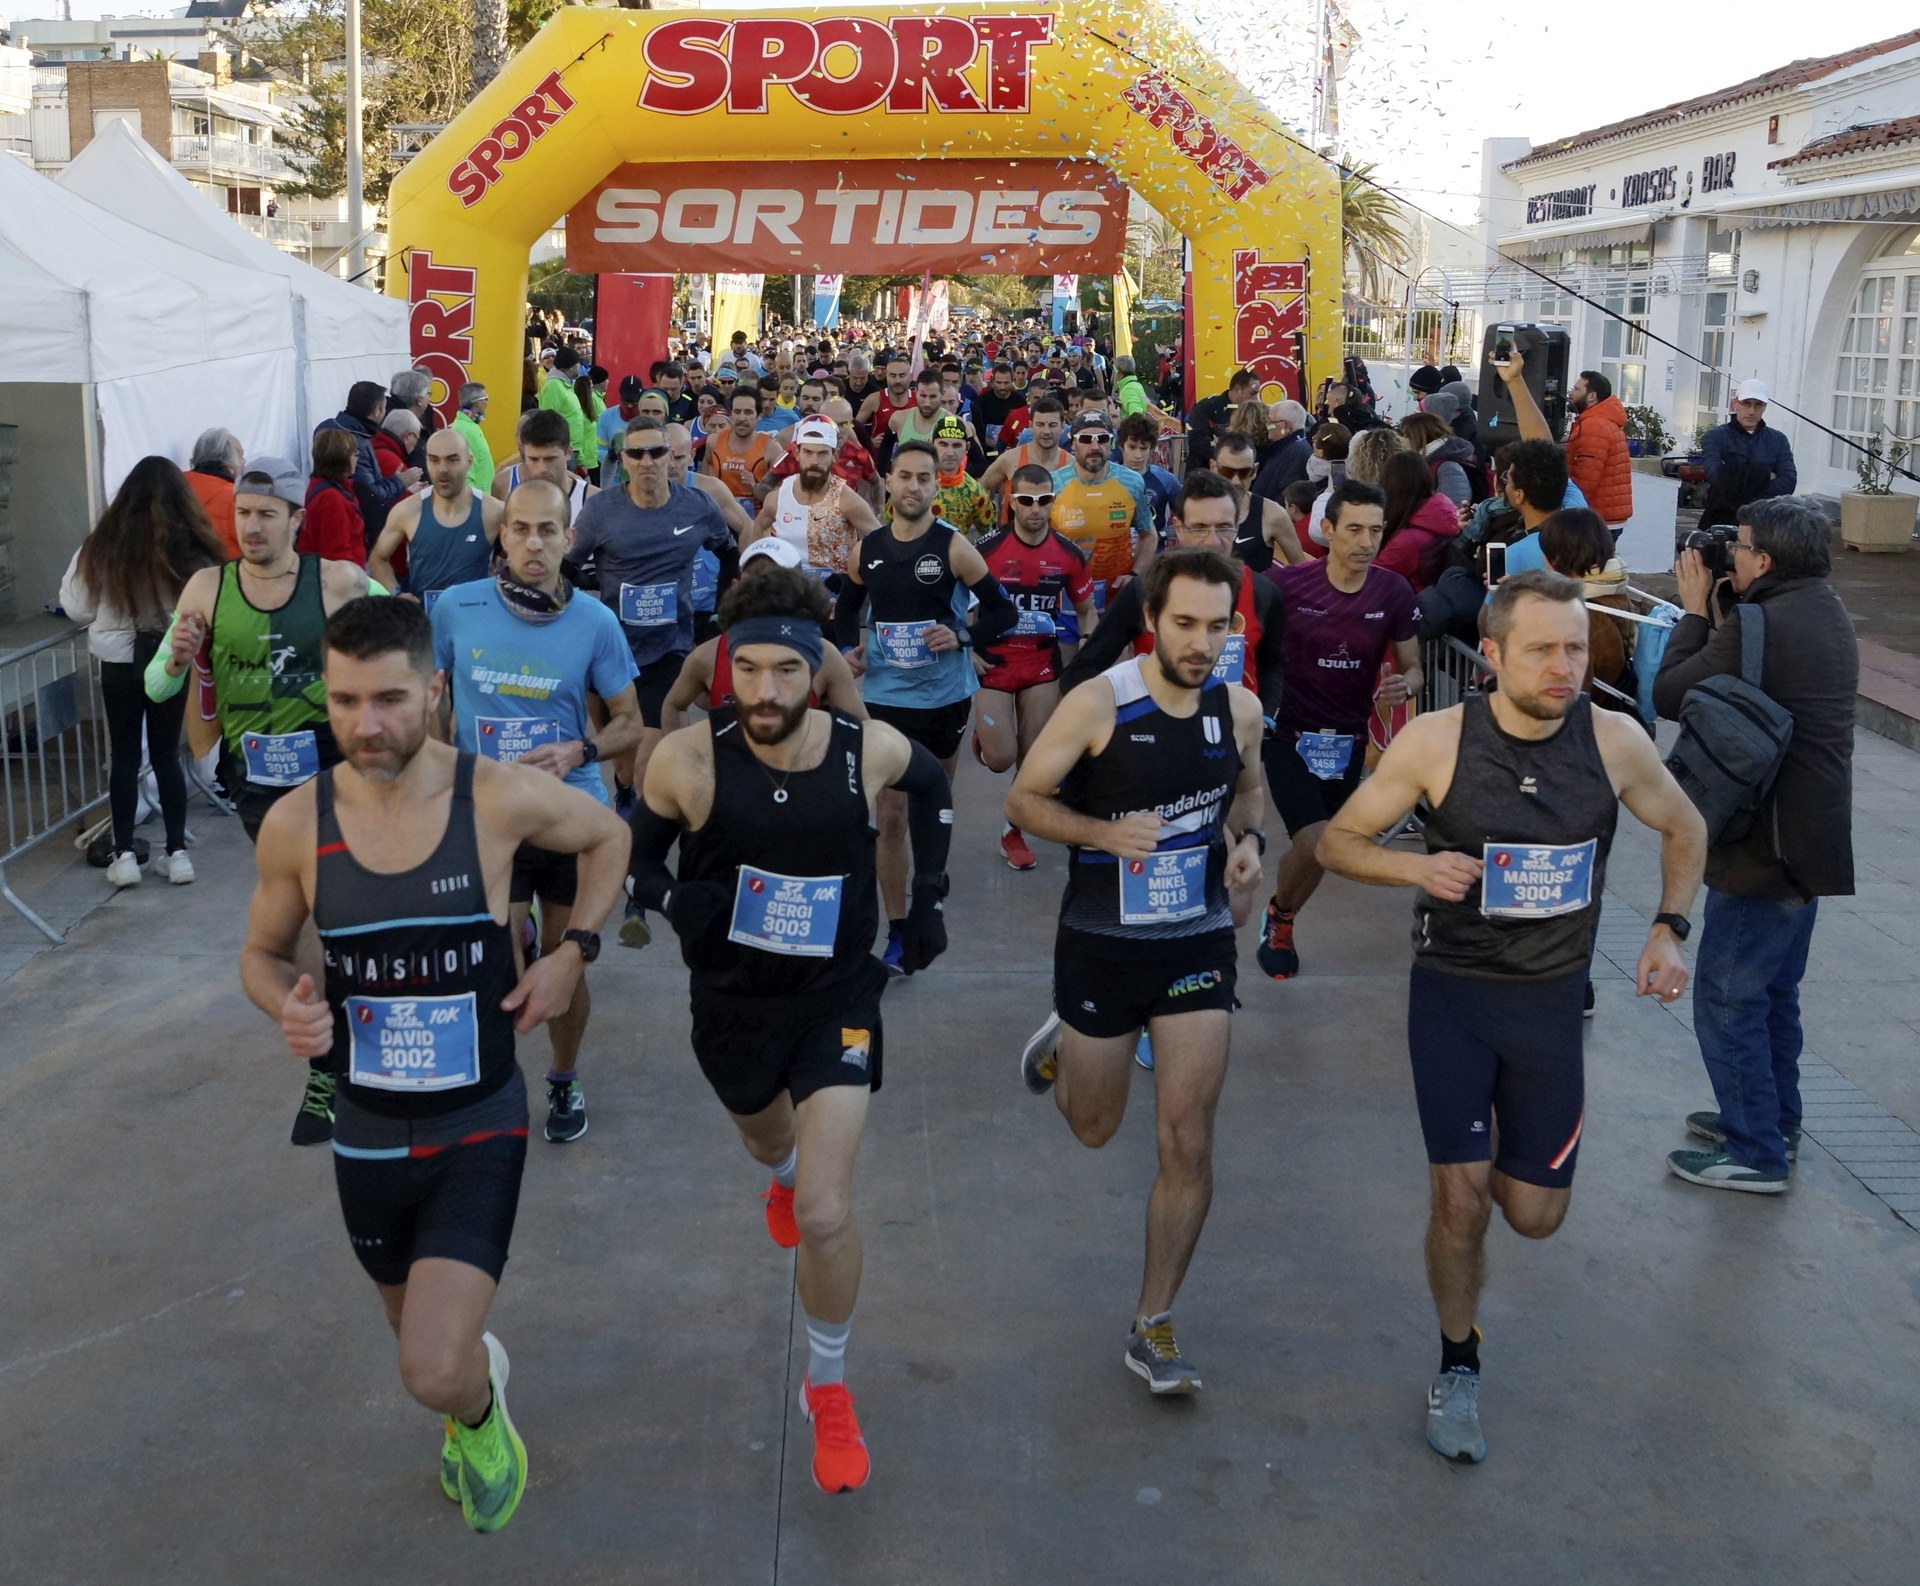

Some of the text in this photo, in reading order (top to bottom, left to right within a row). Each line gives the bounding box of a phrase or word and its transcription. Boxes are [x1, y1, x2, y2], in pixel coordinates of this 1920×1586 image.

[637, 14, 1054, 116] SPORT
[446, 68, 578, 208] SPORT
[1120, 70, 1272, 204] SPORT
[1526, 184, 1597, 224] RESTAURANT
[1622, 165, 1677, 208] KANSAS
[1701, 151, 1736, 193] BAR
[1863, 190, 1916, 214] KANSAS
[594, 188, 1103, 246] SORTIDES
[720, 277, 760, 289] ZONA VIP
[1232, 249, 1306, 402] ORT
[408, 250, 477, 430] ORT
[938, 427, 965, 439] FRESCO
[635, 598, 664, 608] OSCAR
[636, 606, 663, 617] 3383
[886, 639, 909, 648] JORDI
[1225, 640, 1242, 652] 10K
[892, 647, 918, 657] 3008
[1211, 666, 1228, 678] 07
[529, 724, 548, 735] 10K
[293, 737, 313, 749] 10K
[498, 738, 532, 750] SERGI
[263, 752, 298, 762] DAVID
[498, 751, 524, 763] 300
[1307, 749, 1341, 758] MANUEL
[265, 762, 300, 774] 3013
[1310, 758, 1335, 769] 3458
[1154, 783, 1228, 819] Badalona
[431, 873, 470, 895] GOBIK
[1148, 875, 1187, 890] MIKEL
[1503, 869, 1574, 884] MARIUSZ
[812, 886, 838, 901] 10K
[1148, 887, 1188, 907] 3018
[1514, 885, 1562, 901] 3004
[766, 900, 813, 919] SERGI
[762, 915, 811, 937] 3003
[429, 1006, 460, 1025] 10K
[380, 1029, 435, 1047] DAVID
[381, 1048, 436, 1069] 3002
